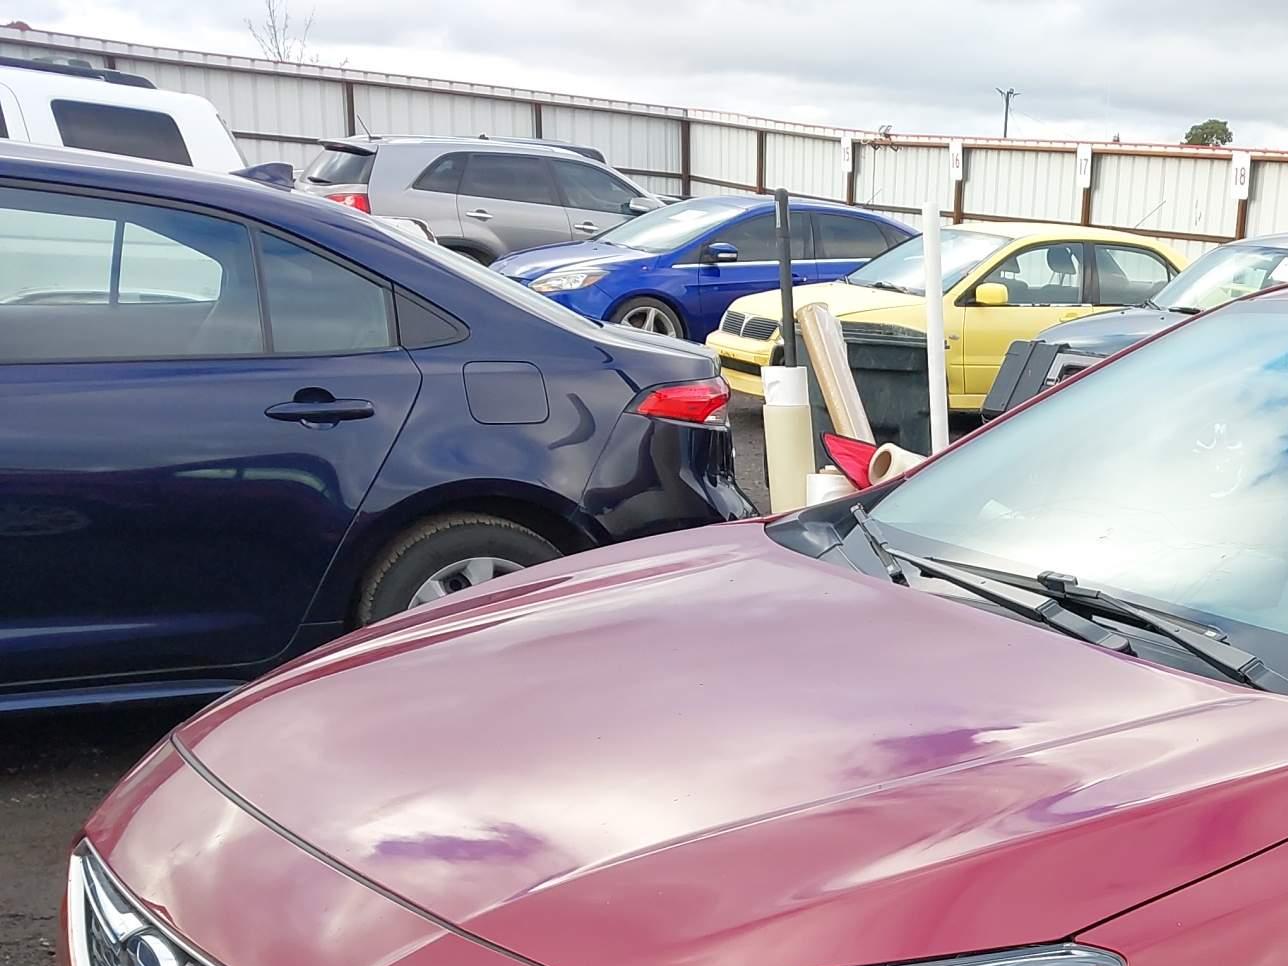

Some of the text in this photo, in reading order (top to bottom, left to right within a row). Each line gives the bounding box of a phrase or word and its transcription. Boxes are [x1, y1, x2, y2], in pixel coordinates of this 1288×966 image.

[951, 152, 961, 169] 16
[1079, 158, 1089, 176] 17
[1234, 167, 1246, 186] 18
